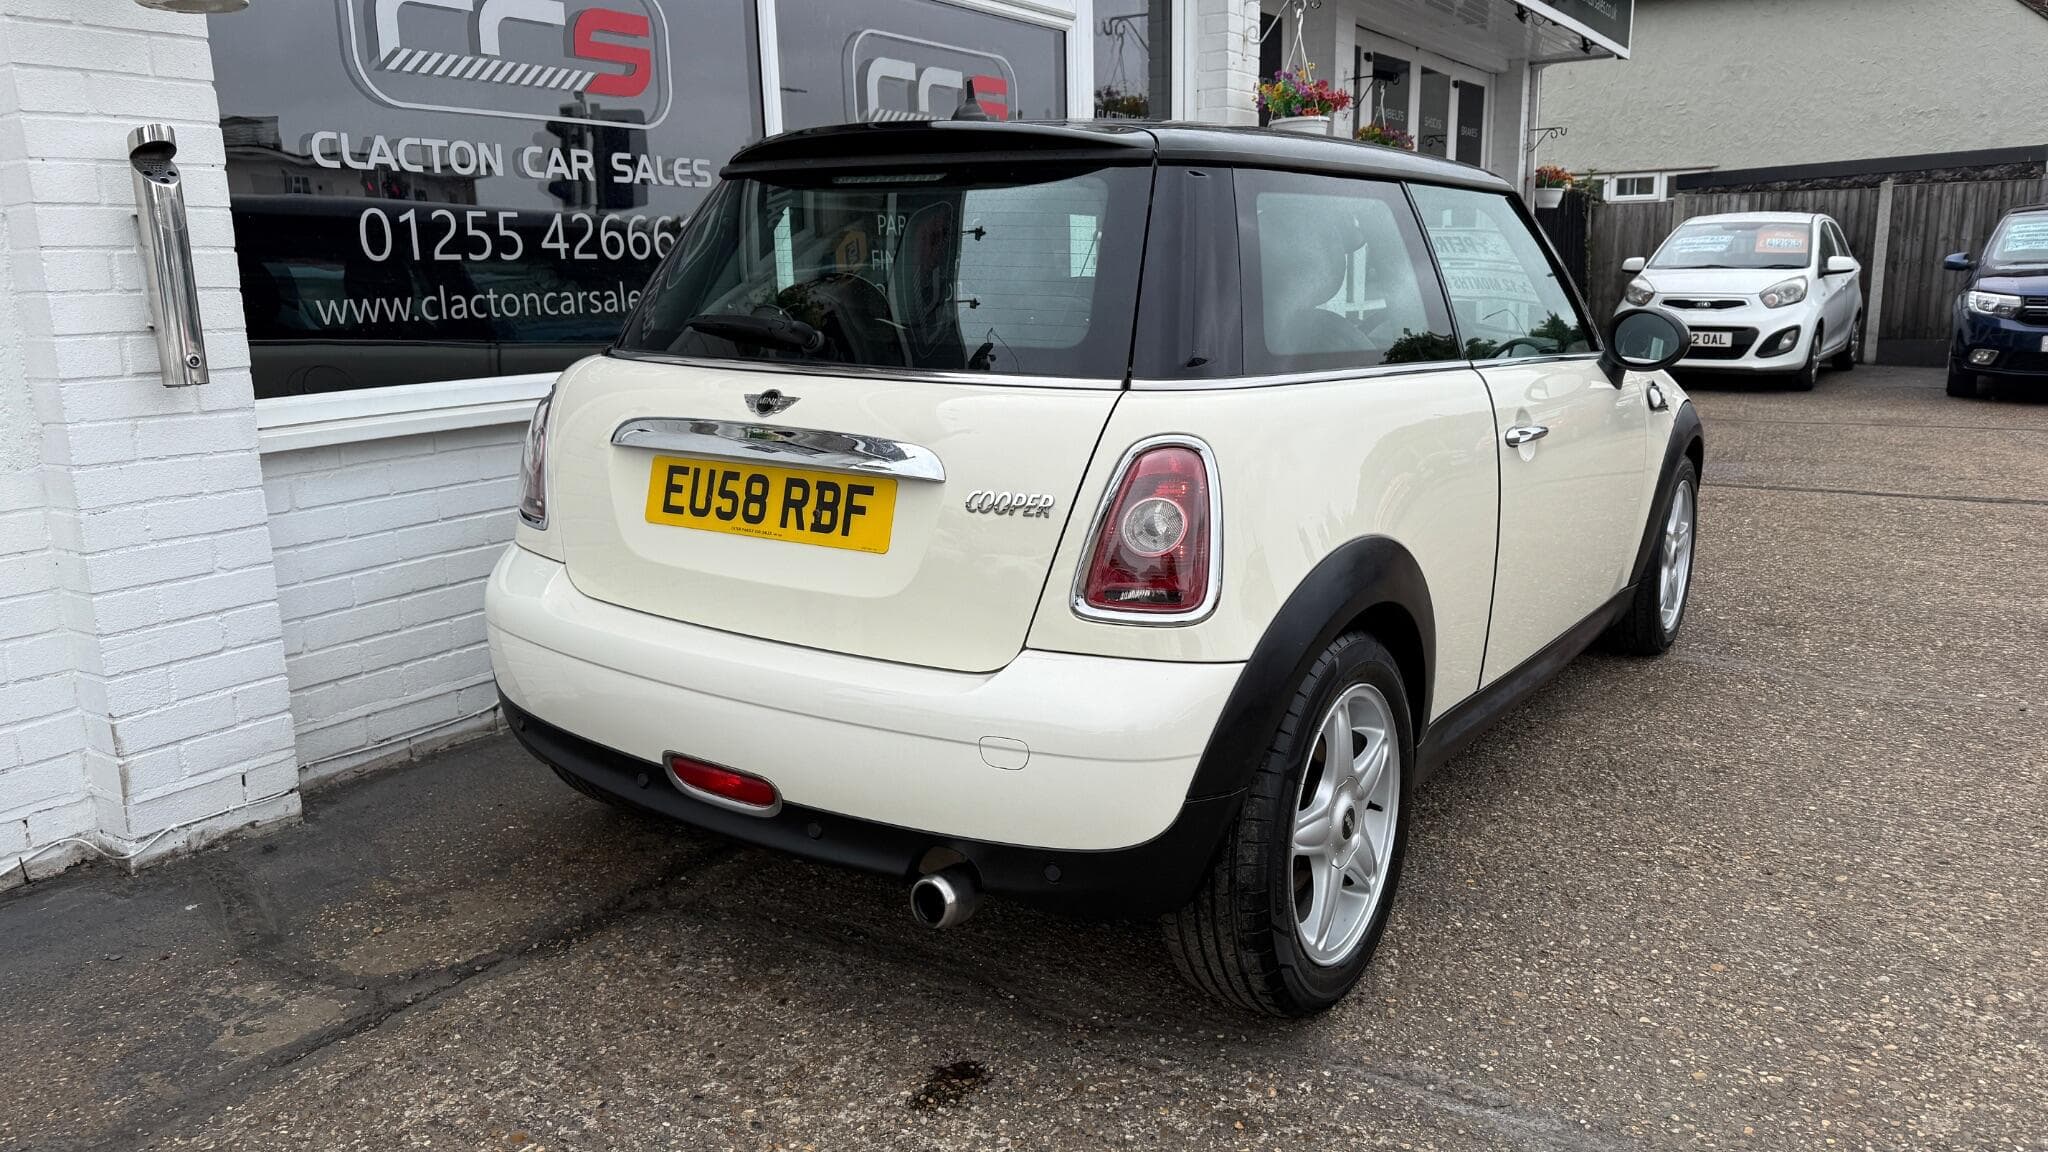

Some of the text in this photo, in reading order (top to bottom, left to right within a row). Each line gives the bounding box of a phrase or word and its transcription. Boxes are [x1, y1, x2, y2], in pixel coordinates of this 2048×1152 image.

[310, 130, 713, 188] CLACTON CAR SALES
[359, 207, 690, 262] 01255 42666
[1702, 333, 1727, 345] OAL
[662, 464, 875, 537] EU58 RBF
[965, 489, 1056, 518] COOPER
